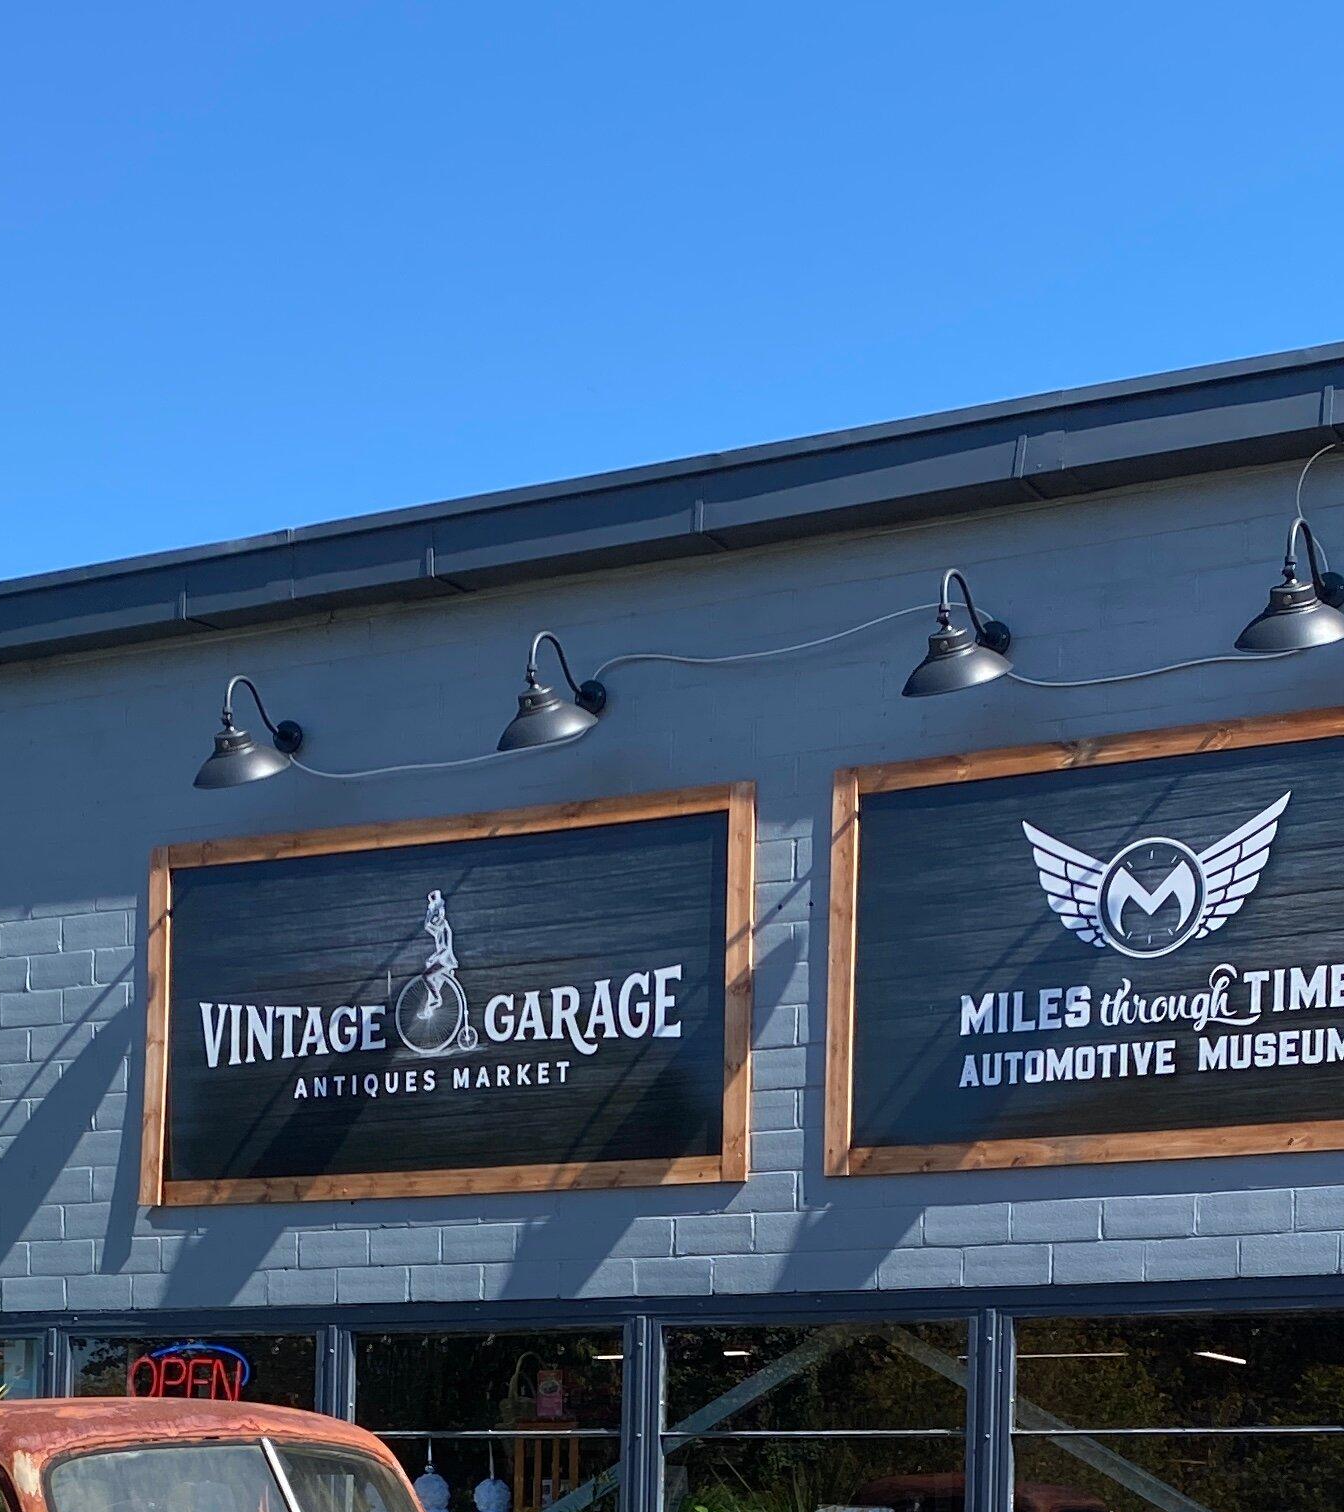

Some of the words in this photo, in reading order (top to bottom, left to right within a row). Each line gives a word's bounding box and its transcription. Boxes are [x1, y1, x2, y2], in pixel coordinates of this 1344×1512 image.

[1107, 860, 1196, 937] M
[199, 1002, 387, 1068] VINTAGE
[484, 964, 682, 1055] GARAGE
[960, 985, 1092, 1036] MILES
[1100, 963, 1261, 1032] through
[294, 1069, 436, 1099] ANTIQUES
[453, 1061, 570, 1089] MARKET
[959, 1041, 1176, 1088] AUTOMOTIVE
[127, 1355, 244, 1401] OPEN
